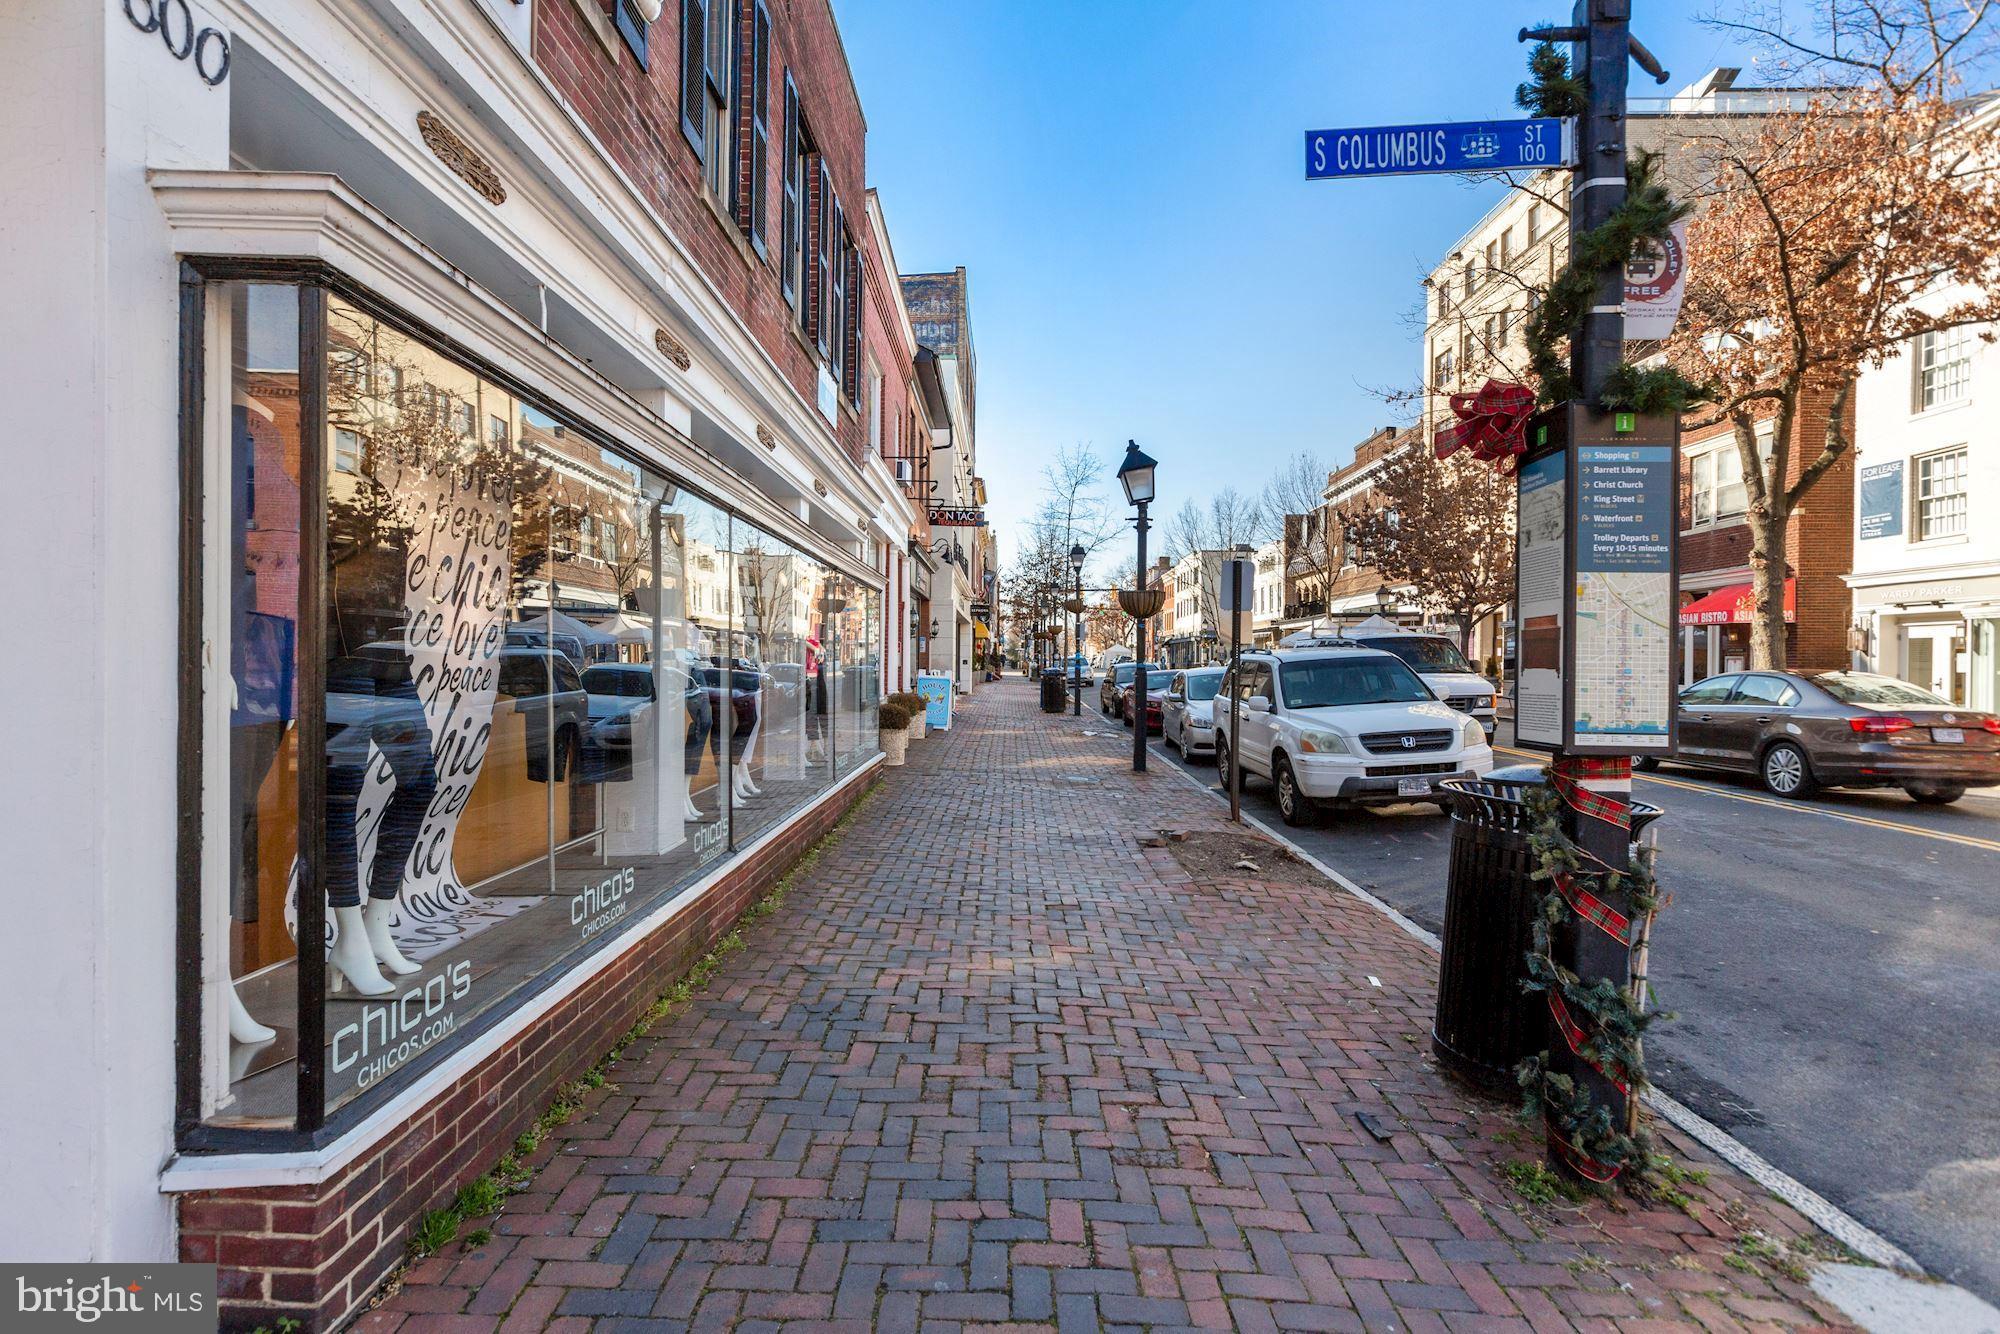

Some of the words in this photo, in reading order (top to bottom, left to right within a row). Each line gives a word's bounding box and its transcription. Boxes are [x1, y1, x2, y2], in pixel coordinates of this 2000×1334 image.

[1524, 124, 1544, 142] ST
[1314, 136, 1326, 172] S
[1337, 130, 1446, 170] COLUMBUS
[1518, 144, 1546, 162] 100
[1665, 239, 1679, 276] OLLEY
[1594, 451, 1630, 460] Shopping
[1593, 466, 1620, 474] Barrett
[1621, 466, 1648, 475] Library
[1862, 468, 1878, 478] FOR
[1878, 462, 1902, 474] LEASE
[1593, 480, 1616, 488] Christ
[1617, 480, 1644, 488] Church
[1593, 495, 1611, 504] King
[1612, 495, 1635, 503] Street
[929, 510, 954, 520] DON
[956, 511, 984, 522] TACO
[1593, 514, 1634, 522] Waterfront
[1593, 534, 1619, 542] Trolley
[1620, 534, 1650, 542] Departs
[1593, 544, 1614, 553] Every
[1615, 544, 1637, 552] 10-15
[1638, 544, 1669, 552] minutes
[1881, 589, 1916, 600] WARBY
[1920, 584, 1963, 596] PARKER
[1700, 611, 1728, 623] BISTRO
[1733, 610, 1754, 621] ASIA
[431, 662, 492, 716] peace
[694, 817, 729, 853] chico's
[571, 866, 635, 926] chico's
[581, 901, 626, 938] CHICOS.COM
[332, 959, 471, 1074] chico's
[357, 1011, 454, 1088] CHICOS.COM
